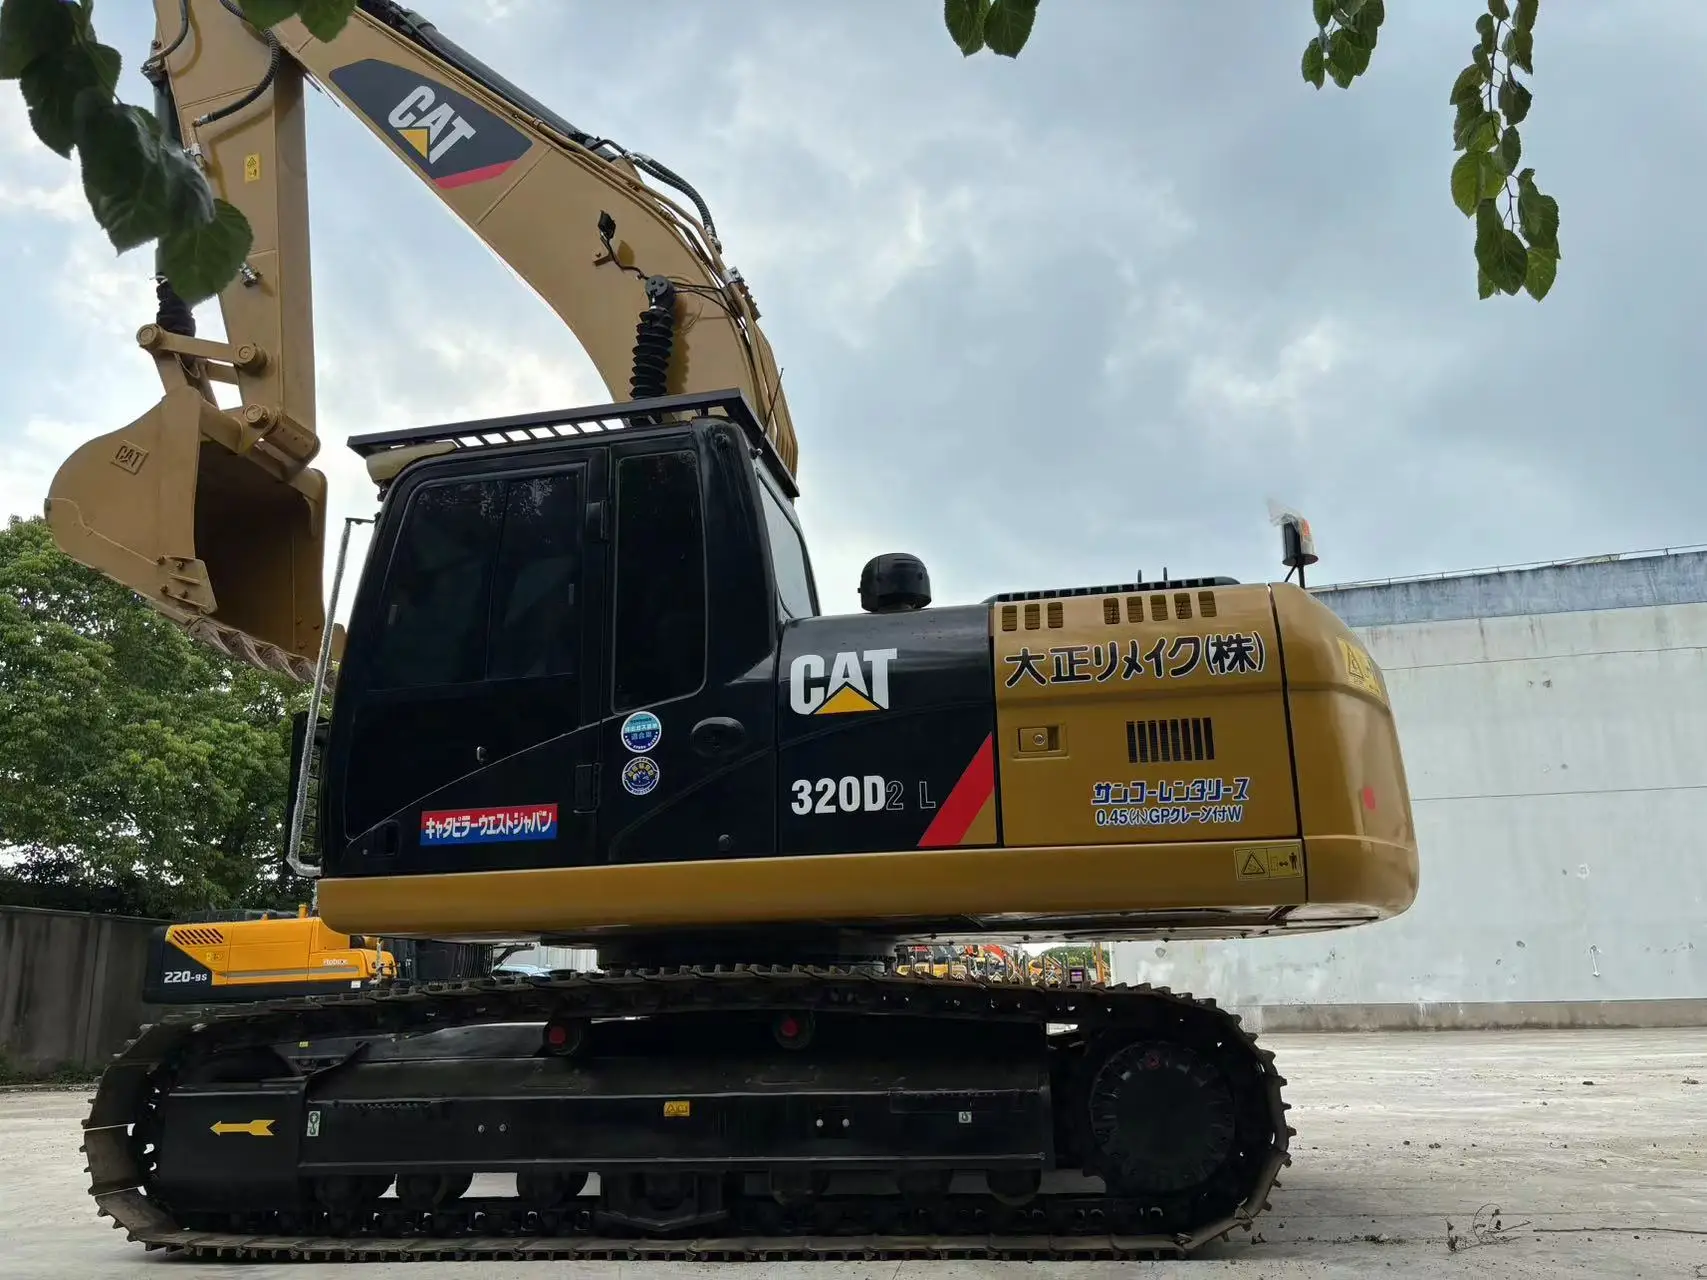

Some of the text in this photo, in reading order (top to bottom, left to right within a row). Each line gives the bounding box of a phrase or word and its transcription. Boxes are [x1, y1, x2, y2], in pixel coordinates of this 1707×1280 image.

[388, 85, 476, 164] CAT
[115, 445, 144, 467] CAT
[1004, 631, 1265, 688] 大正リメイク(株)
[790, 648, 898, 715] CAT
[919, 780, 936, 809] L
[1092, 777, 1249, 805] サンコーレンタリース
[425, 810, 552, 839] キャタピラーウエストジャパン
